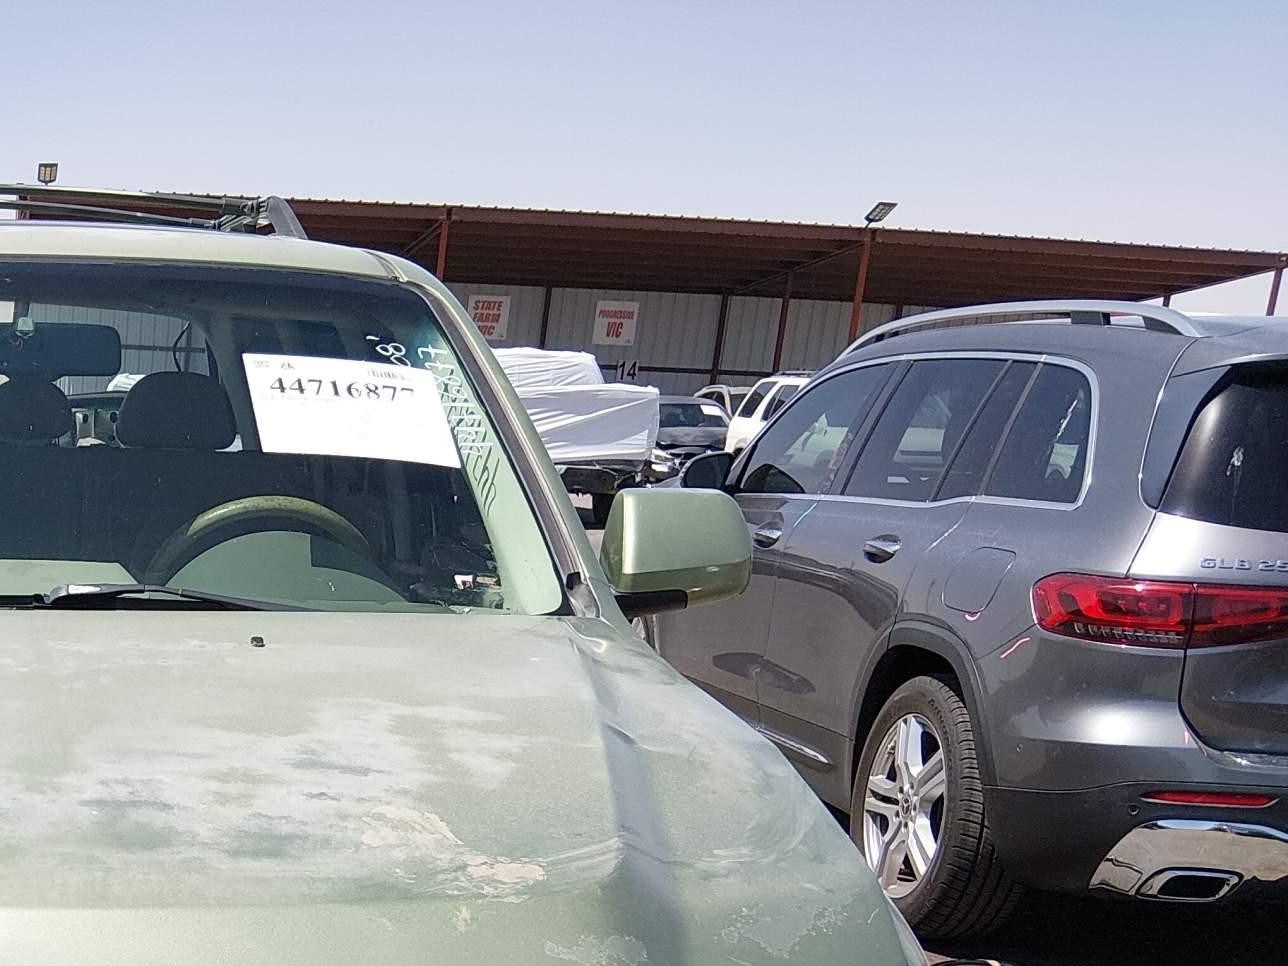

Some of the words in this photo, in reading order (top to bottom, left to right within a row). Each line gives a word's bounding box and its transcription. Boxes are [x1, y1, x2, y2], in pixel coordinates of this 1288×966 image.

[473, 300, 503, 311] STATE
[473, 312, 501, 323] FARM
[598, 309, 635, 320] PROGRESSIVE
[606, 321, 623, 338] VIC
[619, 360, 637, 380] 14
[1200, 558, 1251, 570] GLB
